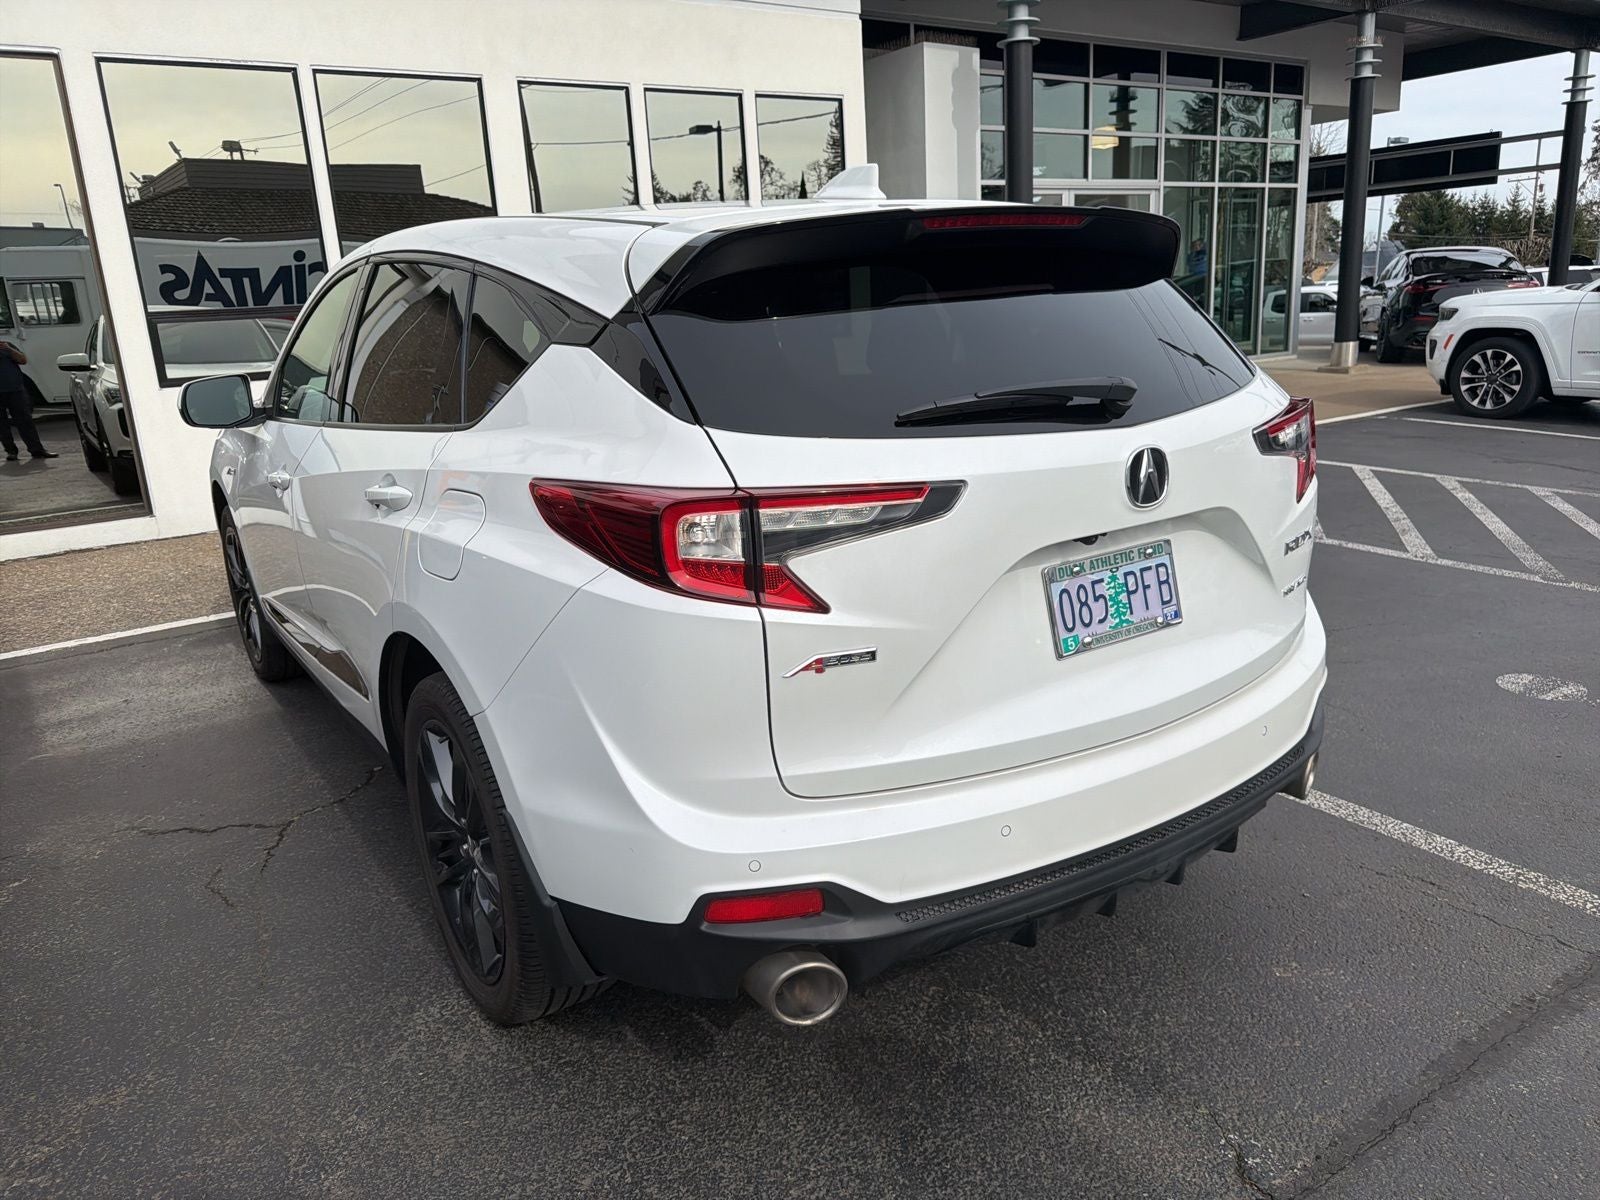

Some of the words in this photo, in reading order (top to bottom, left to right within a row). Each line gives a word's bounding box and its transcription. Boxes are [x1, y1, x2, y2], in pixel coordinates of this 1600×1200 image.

[1057, 561, 1087, 579] DUK
[1089, 550, 1135, 571] ATHLETIC
[1137, 543, 1164, 560] FND
[1058, 578, 1109, 633] 085
[1123, 562, 1173, 615] PFB
[1067, 637, 1075, 650] 5
